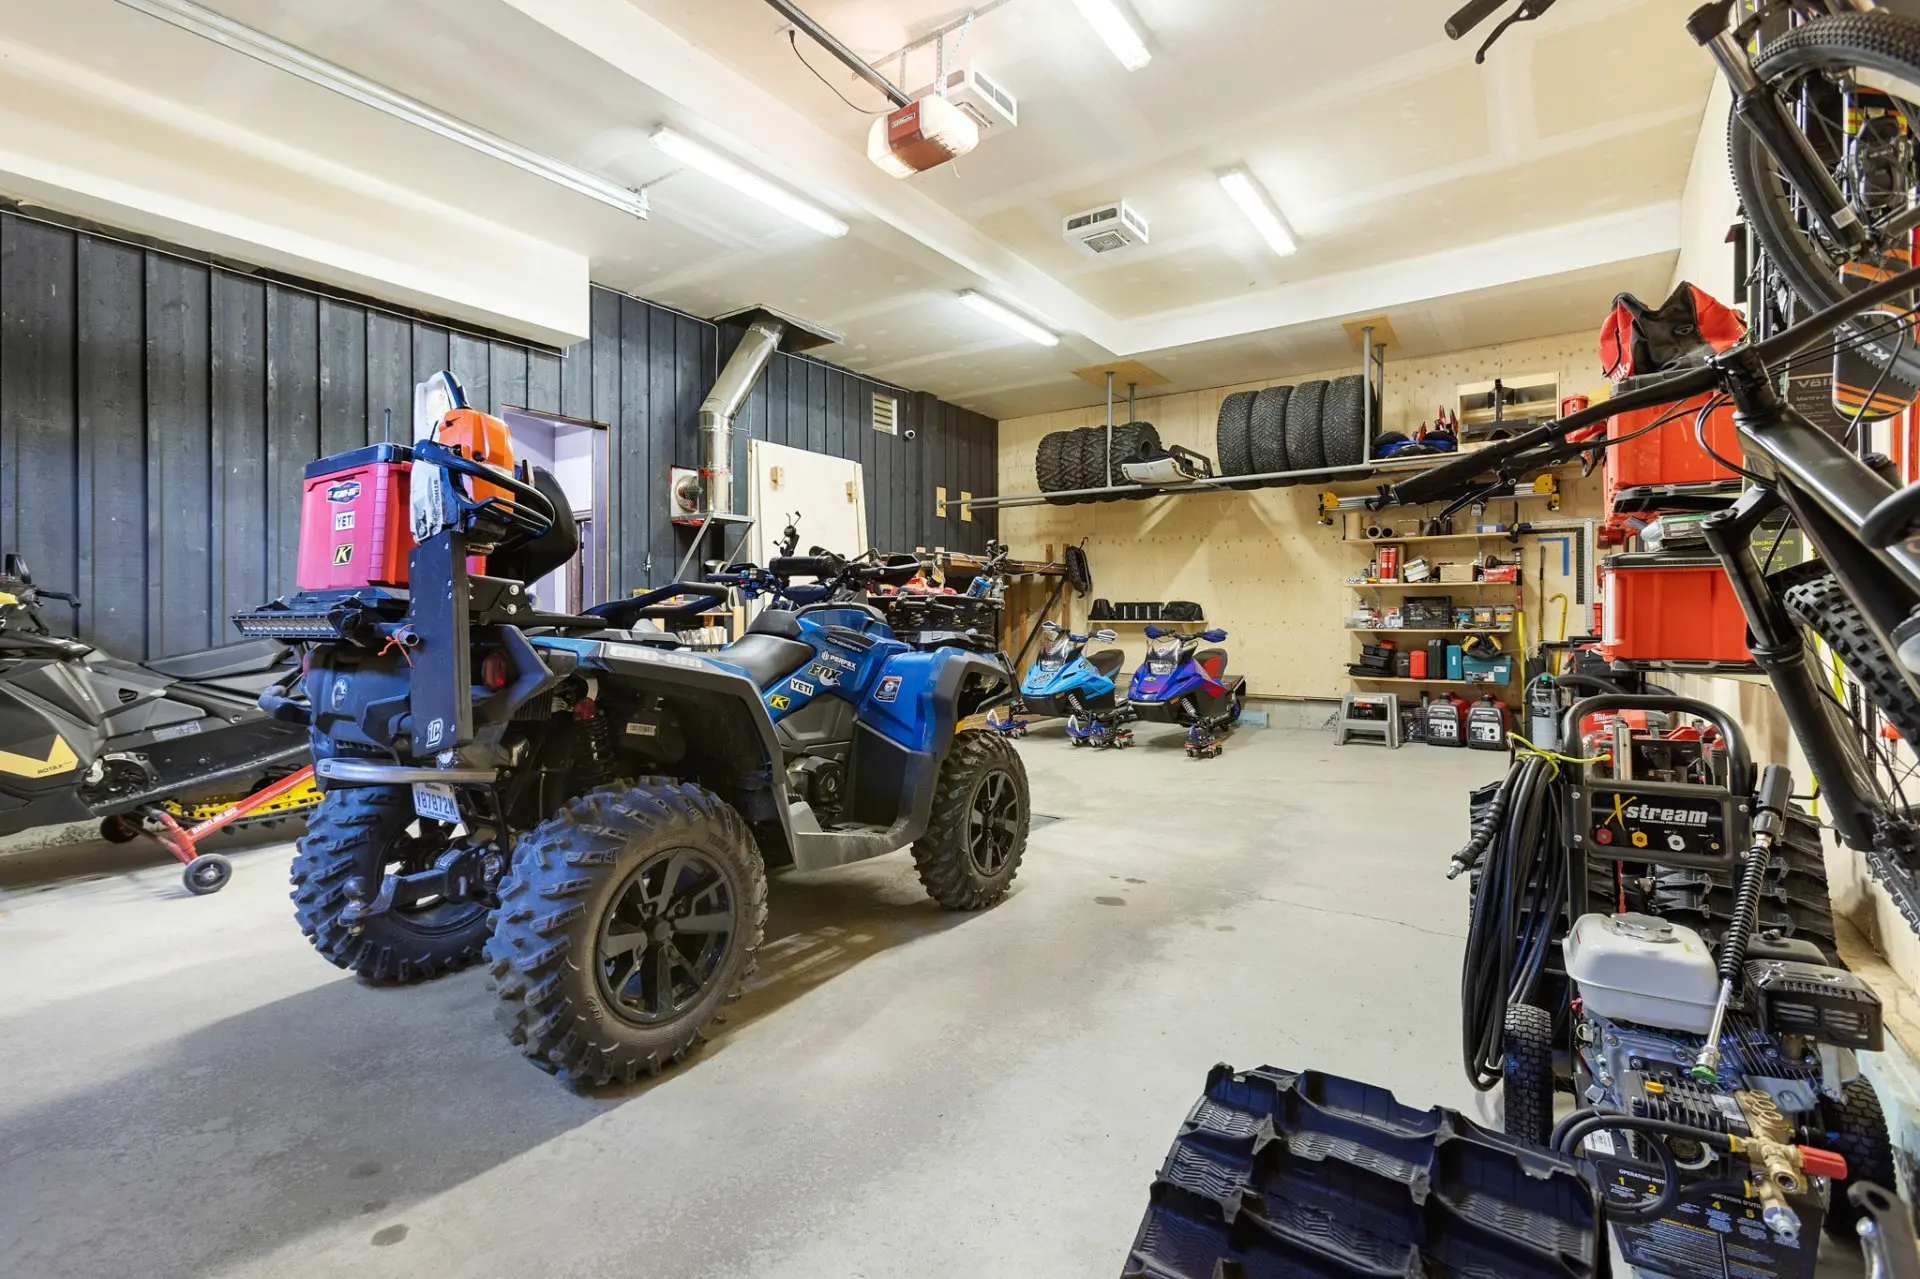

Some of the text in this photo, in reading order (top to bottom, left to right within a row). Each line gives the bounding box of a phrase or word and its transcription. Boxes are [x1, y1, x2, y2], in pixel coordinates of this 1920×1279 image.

[336, 514, 355, 527] YETI
[808, 662, 843, 680] FOX
[792, 680, 813, 694] YETI
[1618, 1169, 1651, 1181] OPERATING
[1618, 1176, 1625, 1186] 1
[1648, 1184, 1657, 1194] 2
[1712, 1200, 1722, 1210] 4
